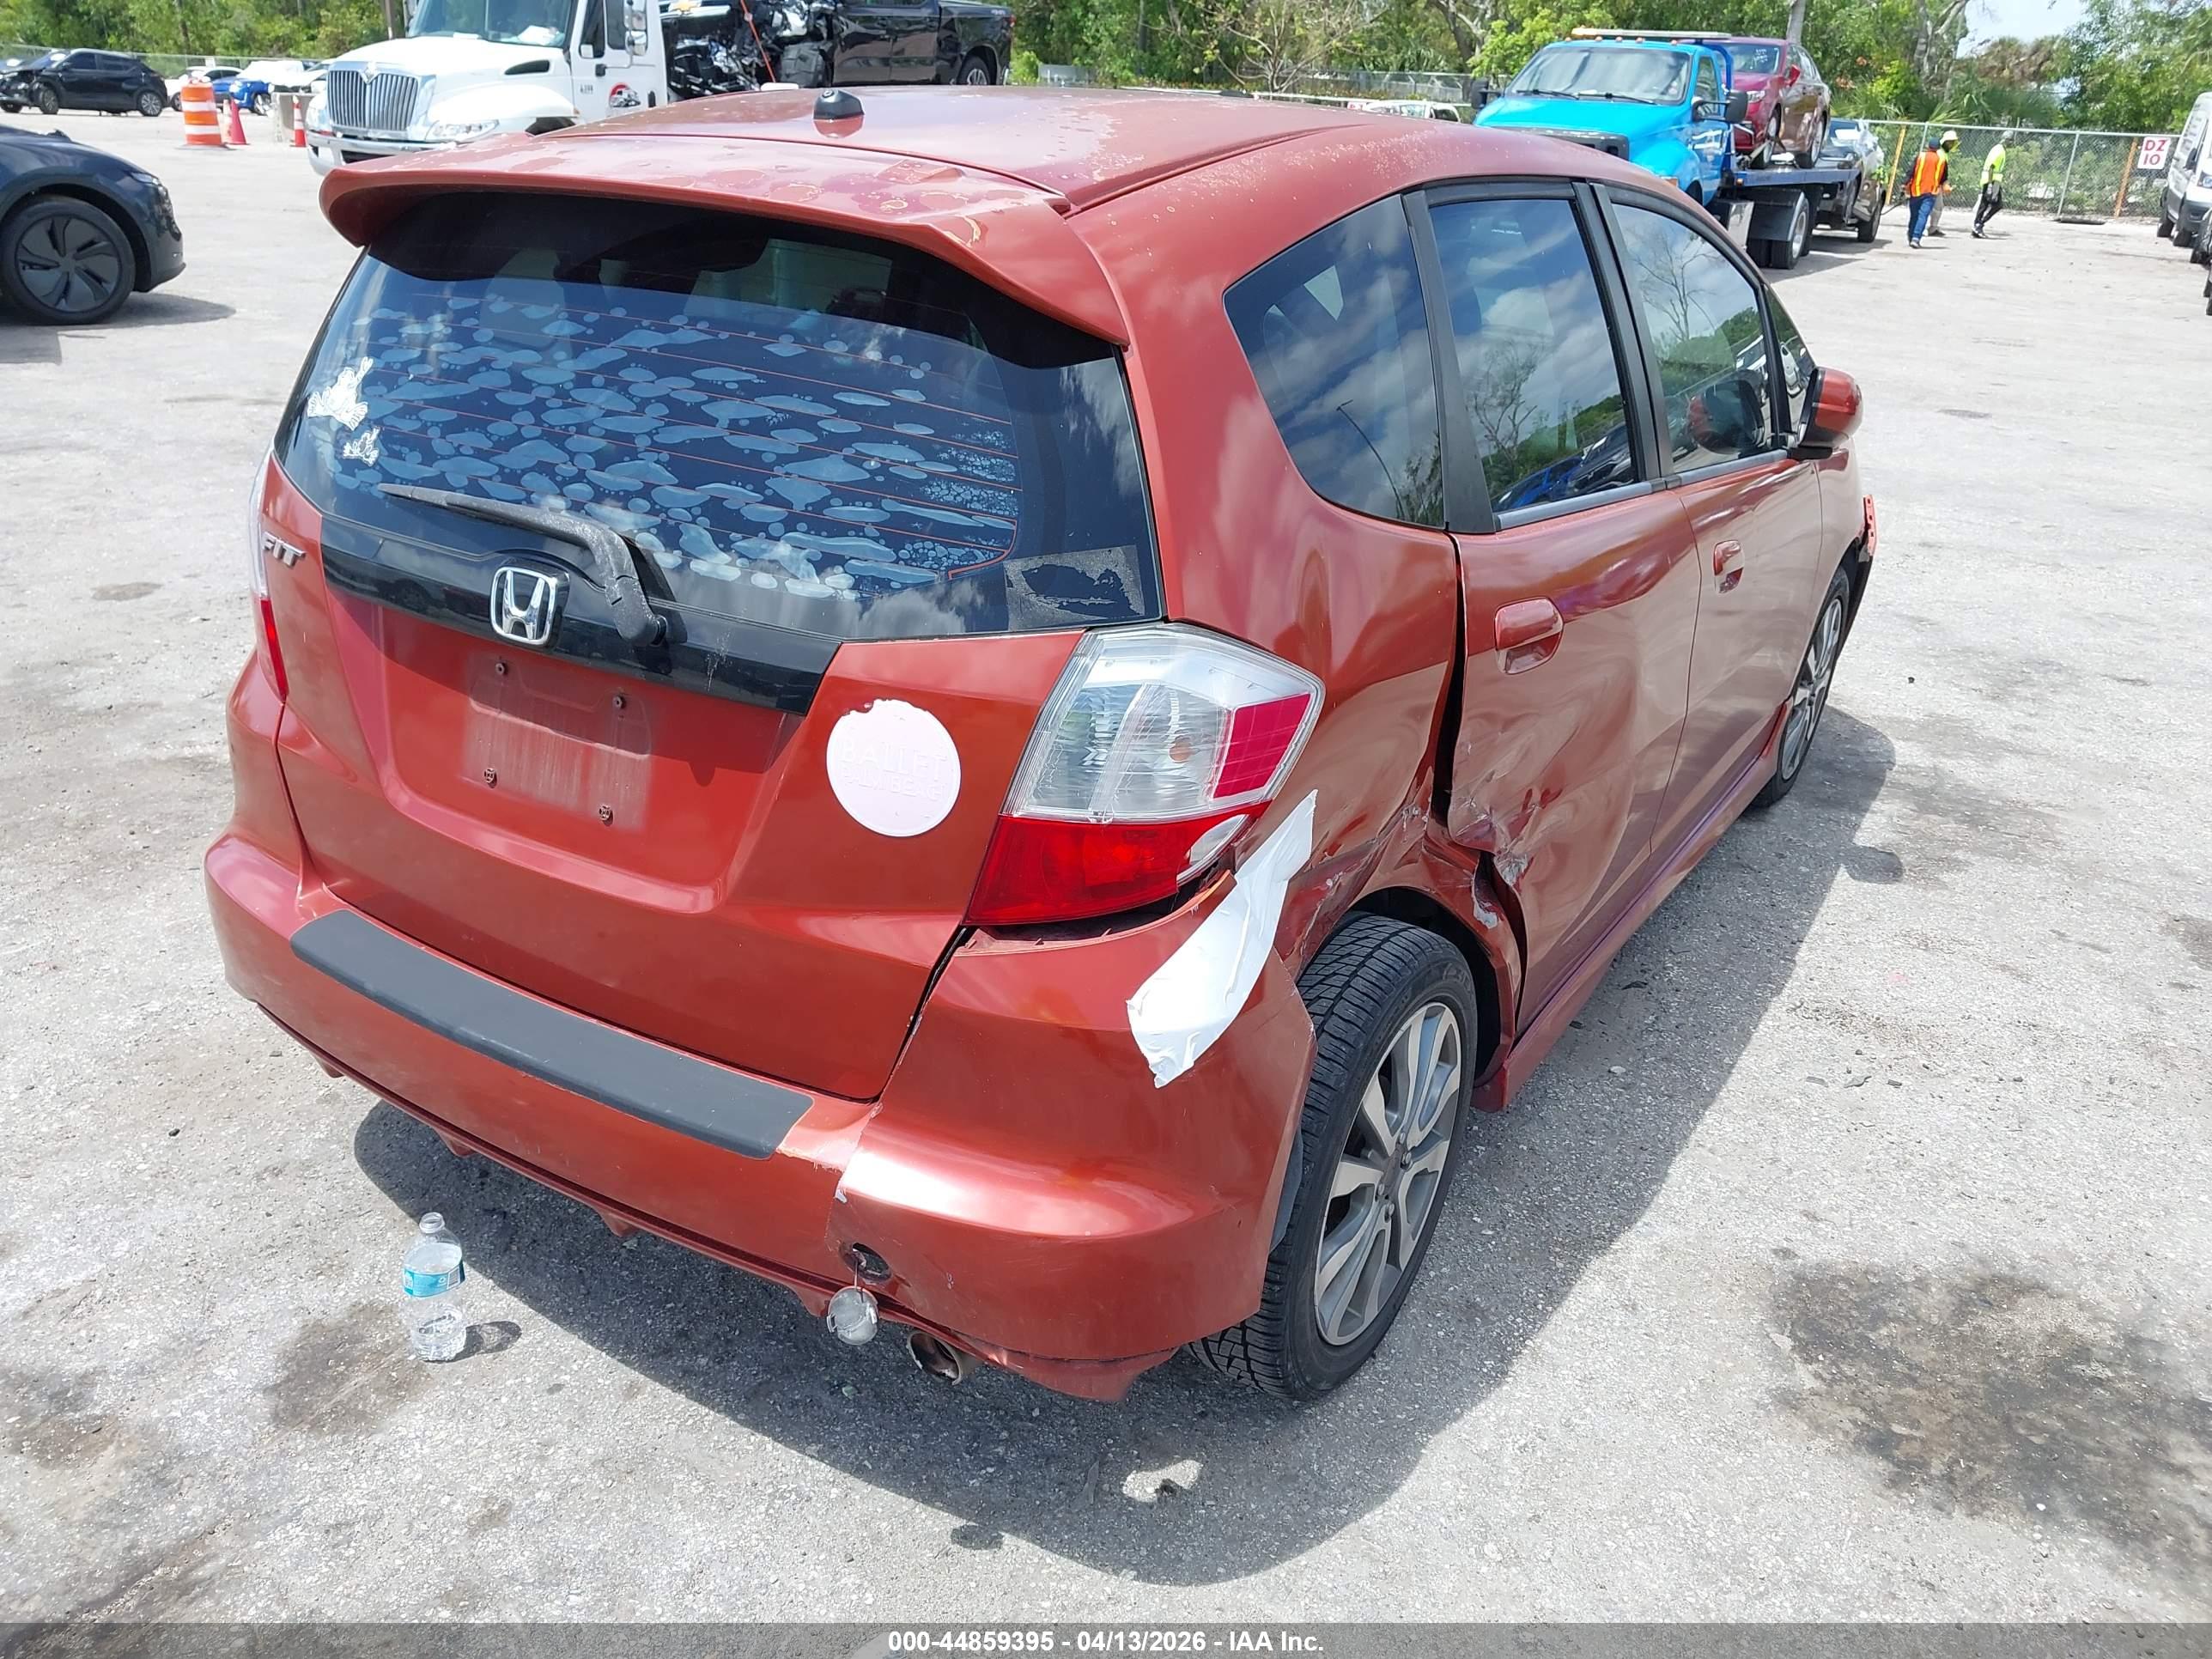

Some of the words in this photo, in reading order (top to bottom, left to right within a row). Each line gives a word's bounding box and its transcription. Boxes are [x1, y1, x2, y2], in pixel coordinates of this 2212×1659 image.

[2144, 139, 2167, 152] DZ
[261, 531, 306, 567] FIT
[839, 740, 948, 782] BALLET
